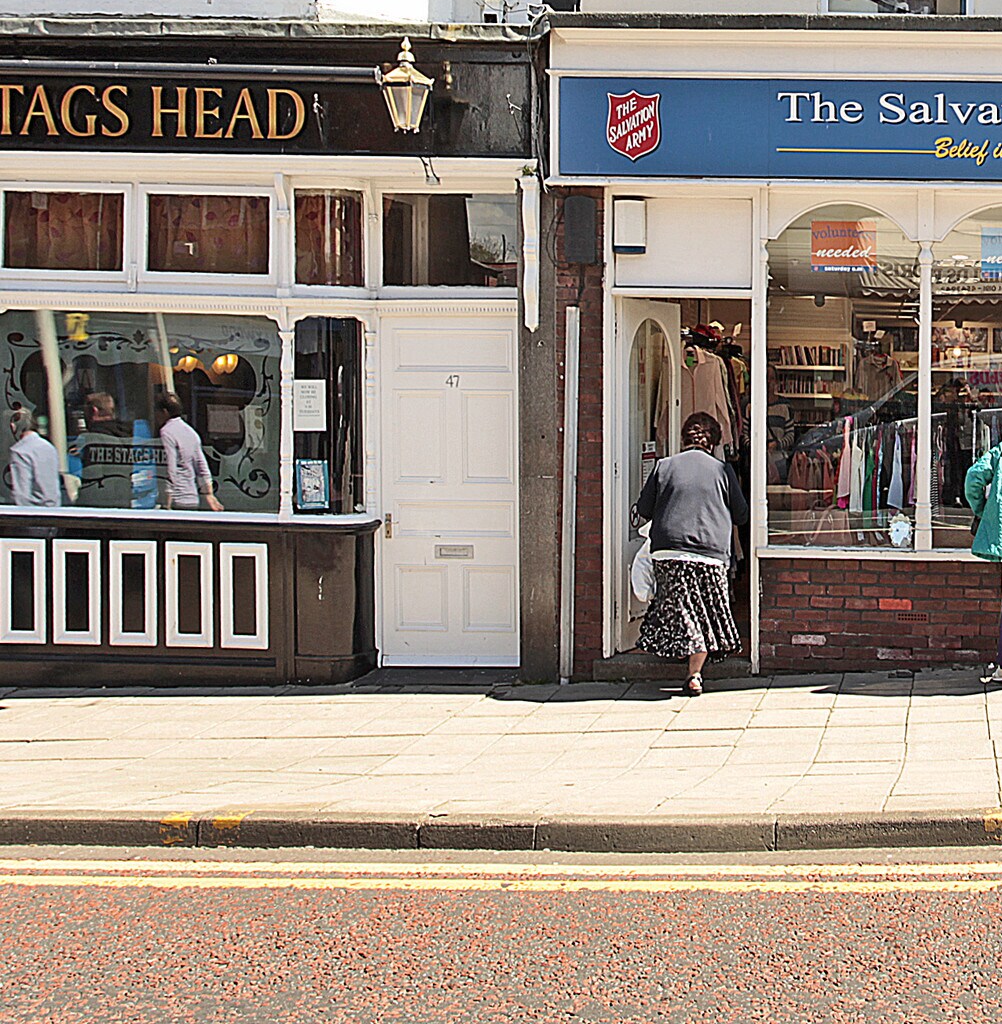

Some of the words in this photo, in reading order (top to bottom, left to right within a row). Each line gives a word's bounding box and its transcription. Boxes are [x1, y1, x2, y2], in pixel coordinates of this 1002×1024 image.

[151, 86, 305, 140] HEAD
[615, 97, 638, 120] THE
[777, 92, 864, 123] The
[609, 100, 655, 143] SALVATION
[626, 121, 654, 152] ARMY
[934, 136, 989, 166] Belief
[816, 245, 872, 258] needed
[824, 266, 850, 274] saturday
[445, 374, 460, 388] 47
[89, 446, 114, 463] THE
[114, 447, 151, 464] STAGS
[152, 449, 168, 464] HE
